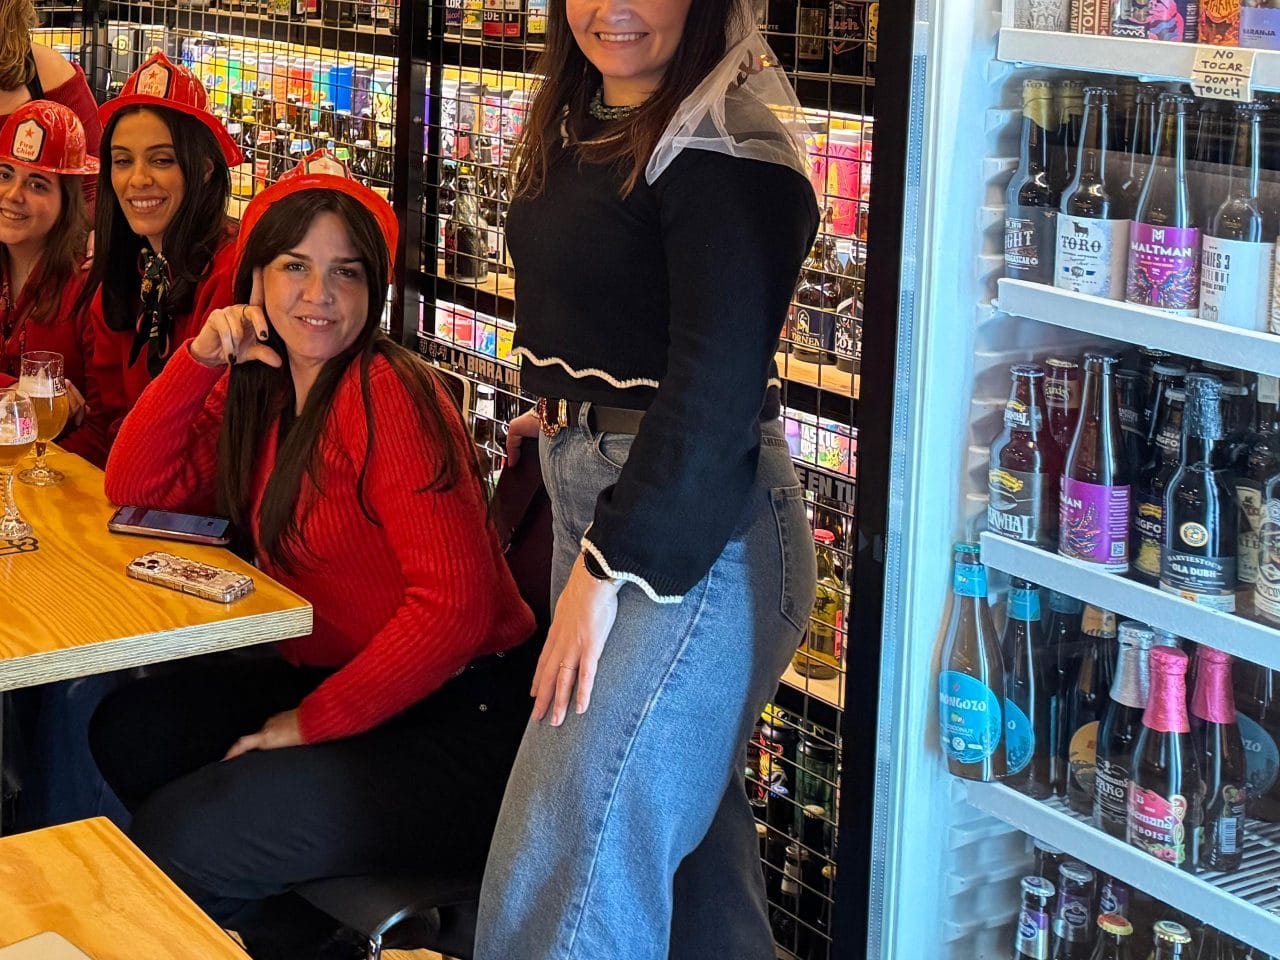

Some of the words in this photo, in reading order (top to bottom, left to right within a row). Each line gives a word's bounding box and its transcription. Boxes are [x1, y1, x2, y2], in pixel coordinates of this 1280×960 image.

[1213, 50, 1234, 59] NO
[1201, 60, 1243, 72] TOCAR
[1204, 76, 1242, 86] DON'T
[1195, 85, 1240, 98] TOUCH
[19, 141, 34, 149] Fire
[16, 147, 35, 156] Chief
[1061, 235, 1102, 253] TORO
[1131, 240, 1192, 257] MALTMAN
[1224, 254, 1231, 270] 3
[451, 349, 466, 369] LA
[467, 355, 503, 382] BIRRA
[808, 471, 833, 496] EN
[1190, 567, 1217, 578] DUBH
